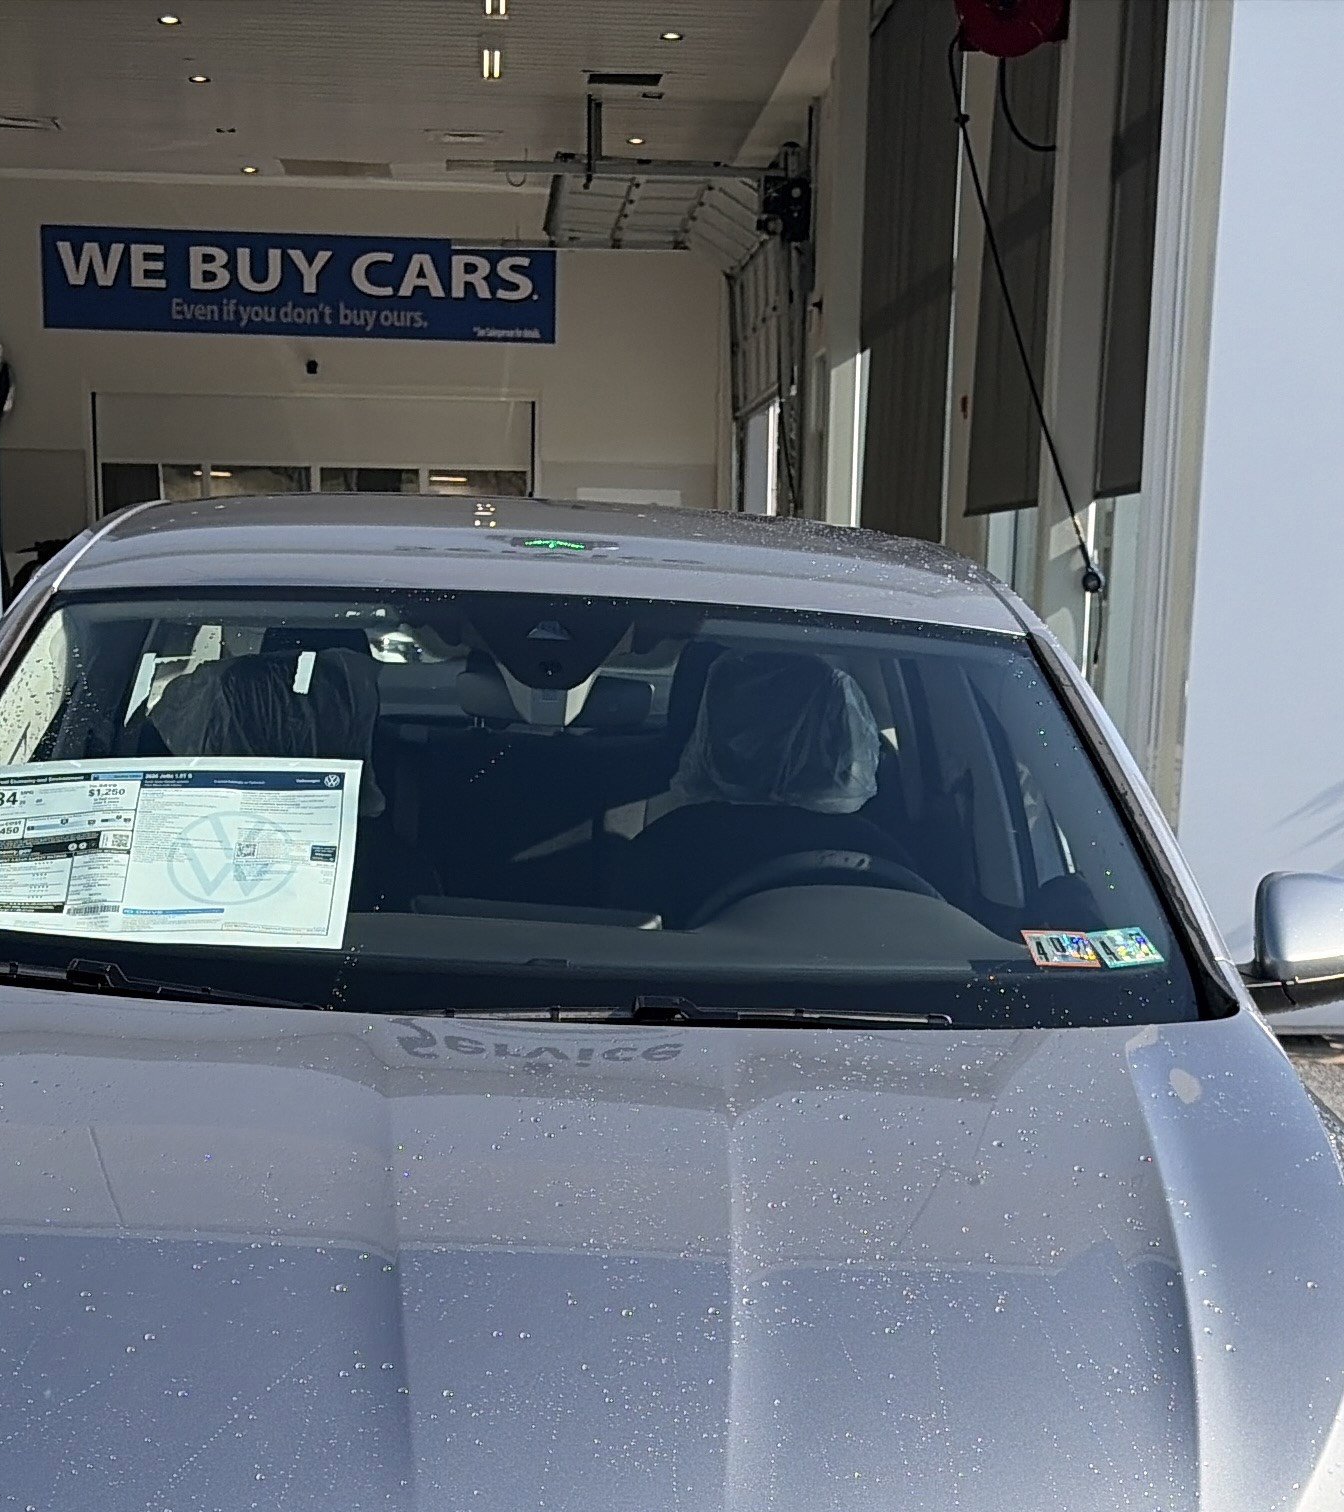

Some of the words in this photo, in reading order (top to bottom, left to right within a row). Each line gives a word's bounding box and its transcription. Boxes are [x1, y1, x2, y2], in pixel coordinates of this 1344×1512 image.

[55, 240, 167, 290] WE
[188, 245, 335, 295] BUY
[351, 250, 538, 302] CARS.
[171, 297, 221, 322] Even
[223, 298, 236, 322] if
[239, 304, 277, 328] you
[279, 300, 332, 325] don't
[339, 301, 383, 332] buy
[383, 309, 428, 328] ours.
[88, 788, 125, 798] $1,250
